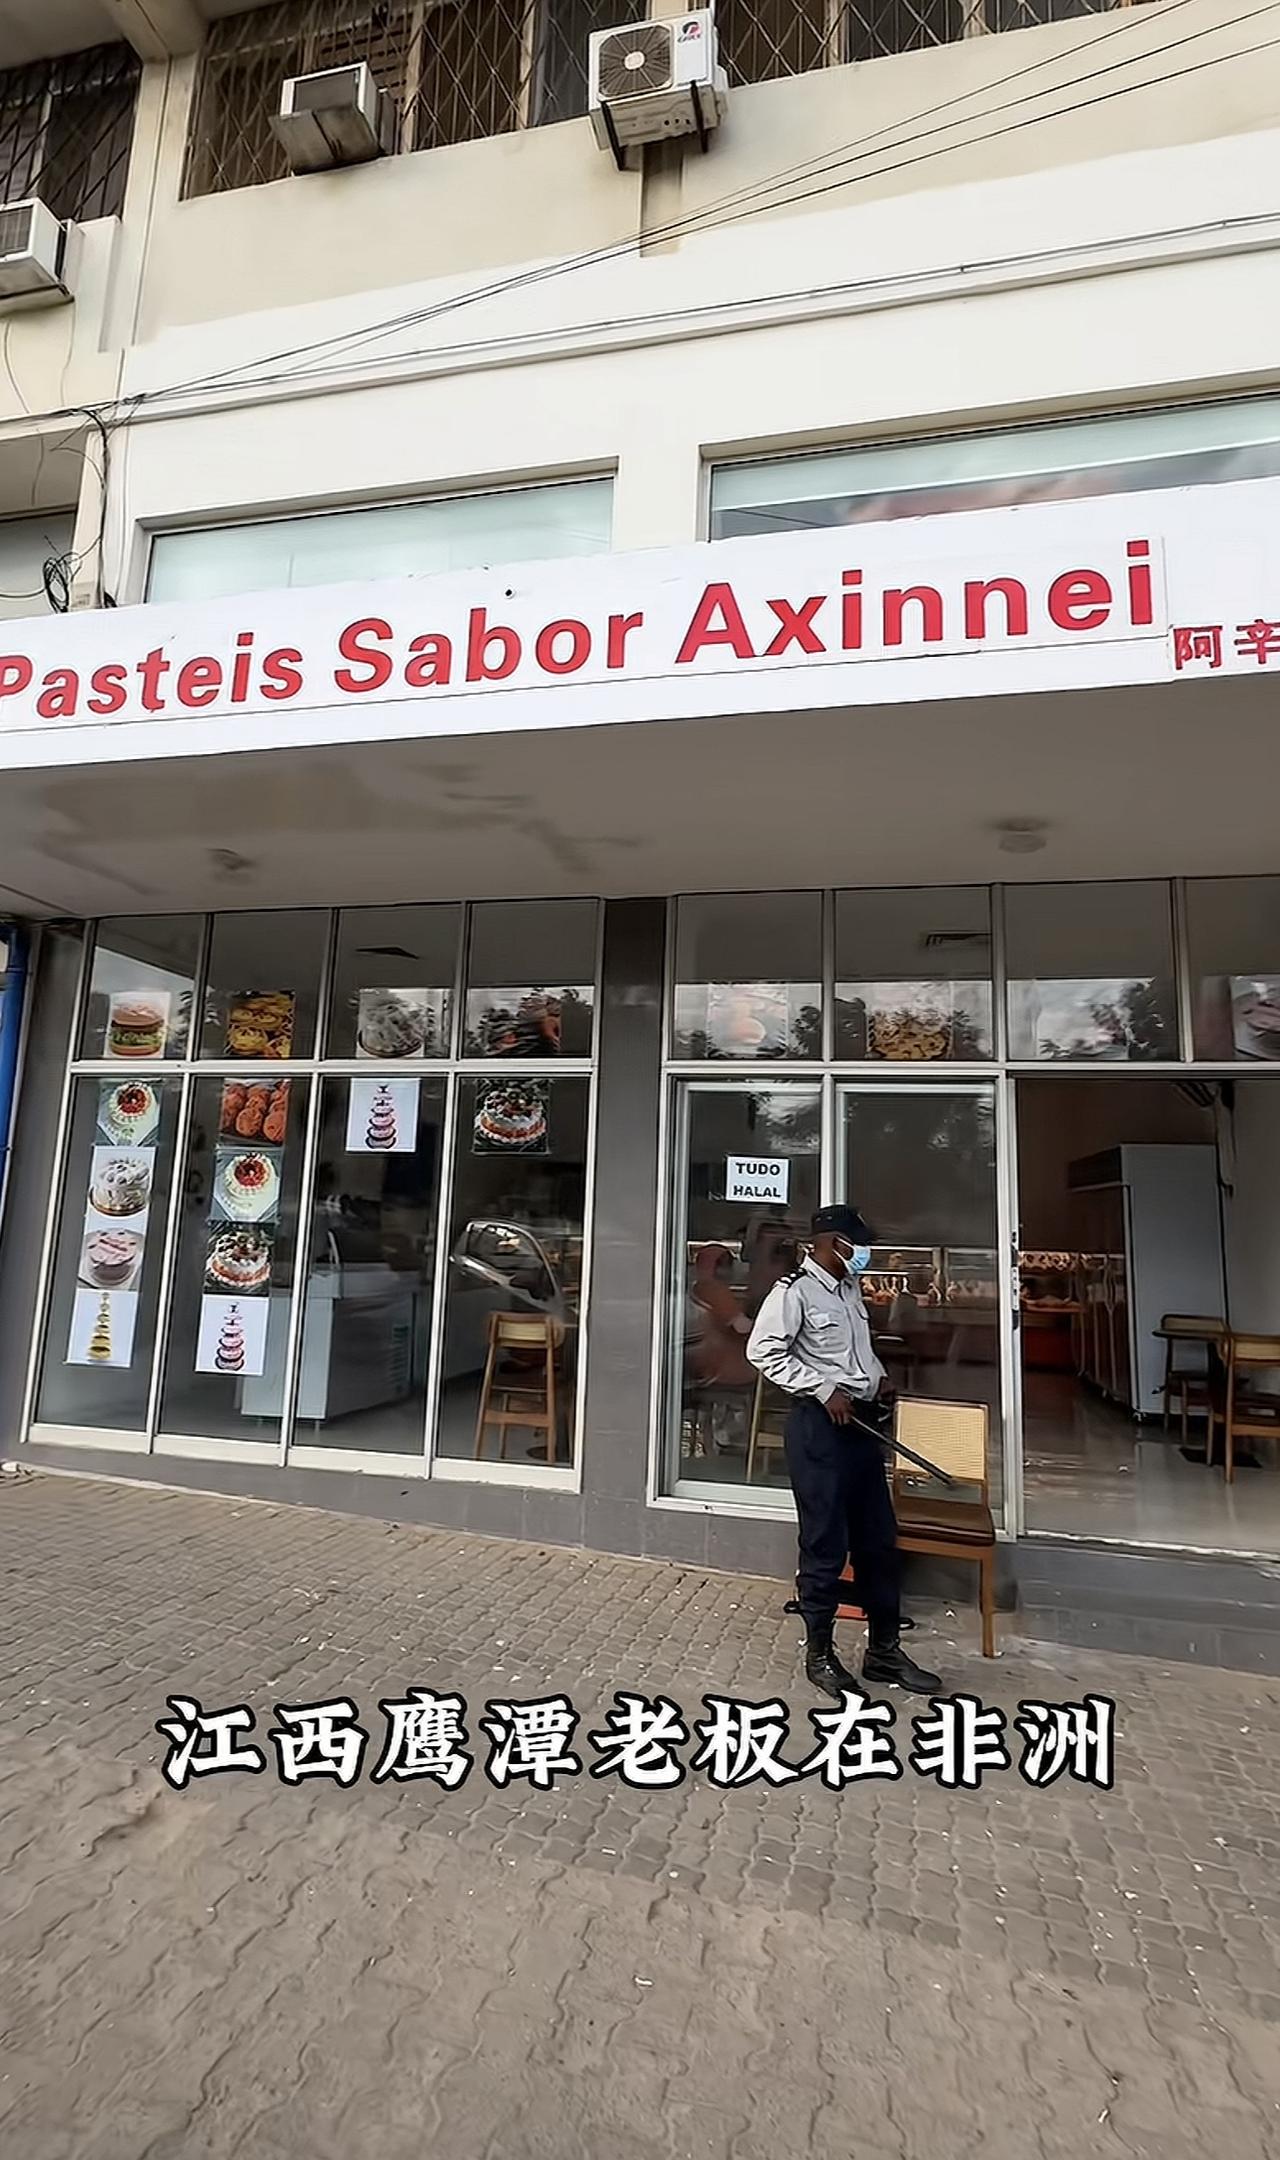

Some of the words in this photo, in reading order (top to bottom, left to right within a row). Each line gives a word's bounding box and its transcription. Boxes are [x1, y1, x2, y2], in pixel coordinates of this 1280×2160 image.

[0, 632, 304, 719] Pasteis
[334, 607, 645, 694] Sabor
[675, 540, 1154, 664] Axinnei
[1172, 618, 1280, 671] 阿辛
[735, 1162, 780, 1176] TUDO
[733, 1185, 781, 1198] HALAL
